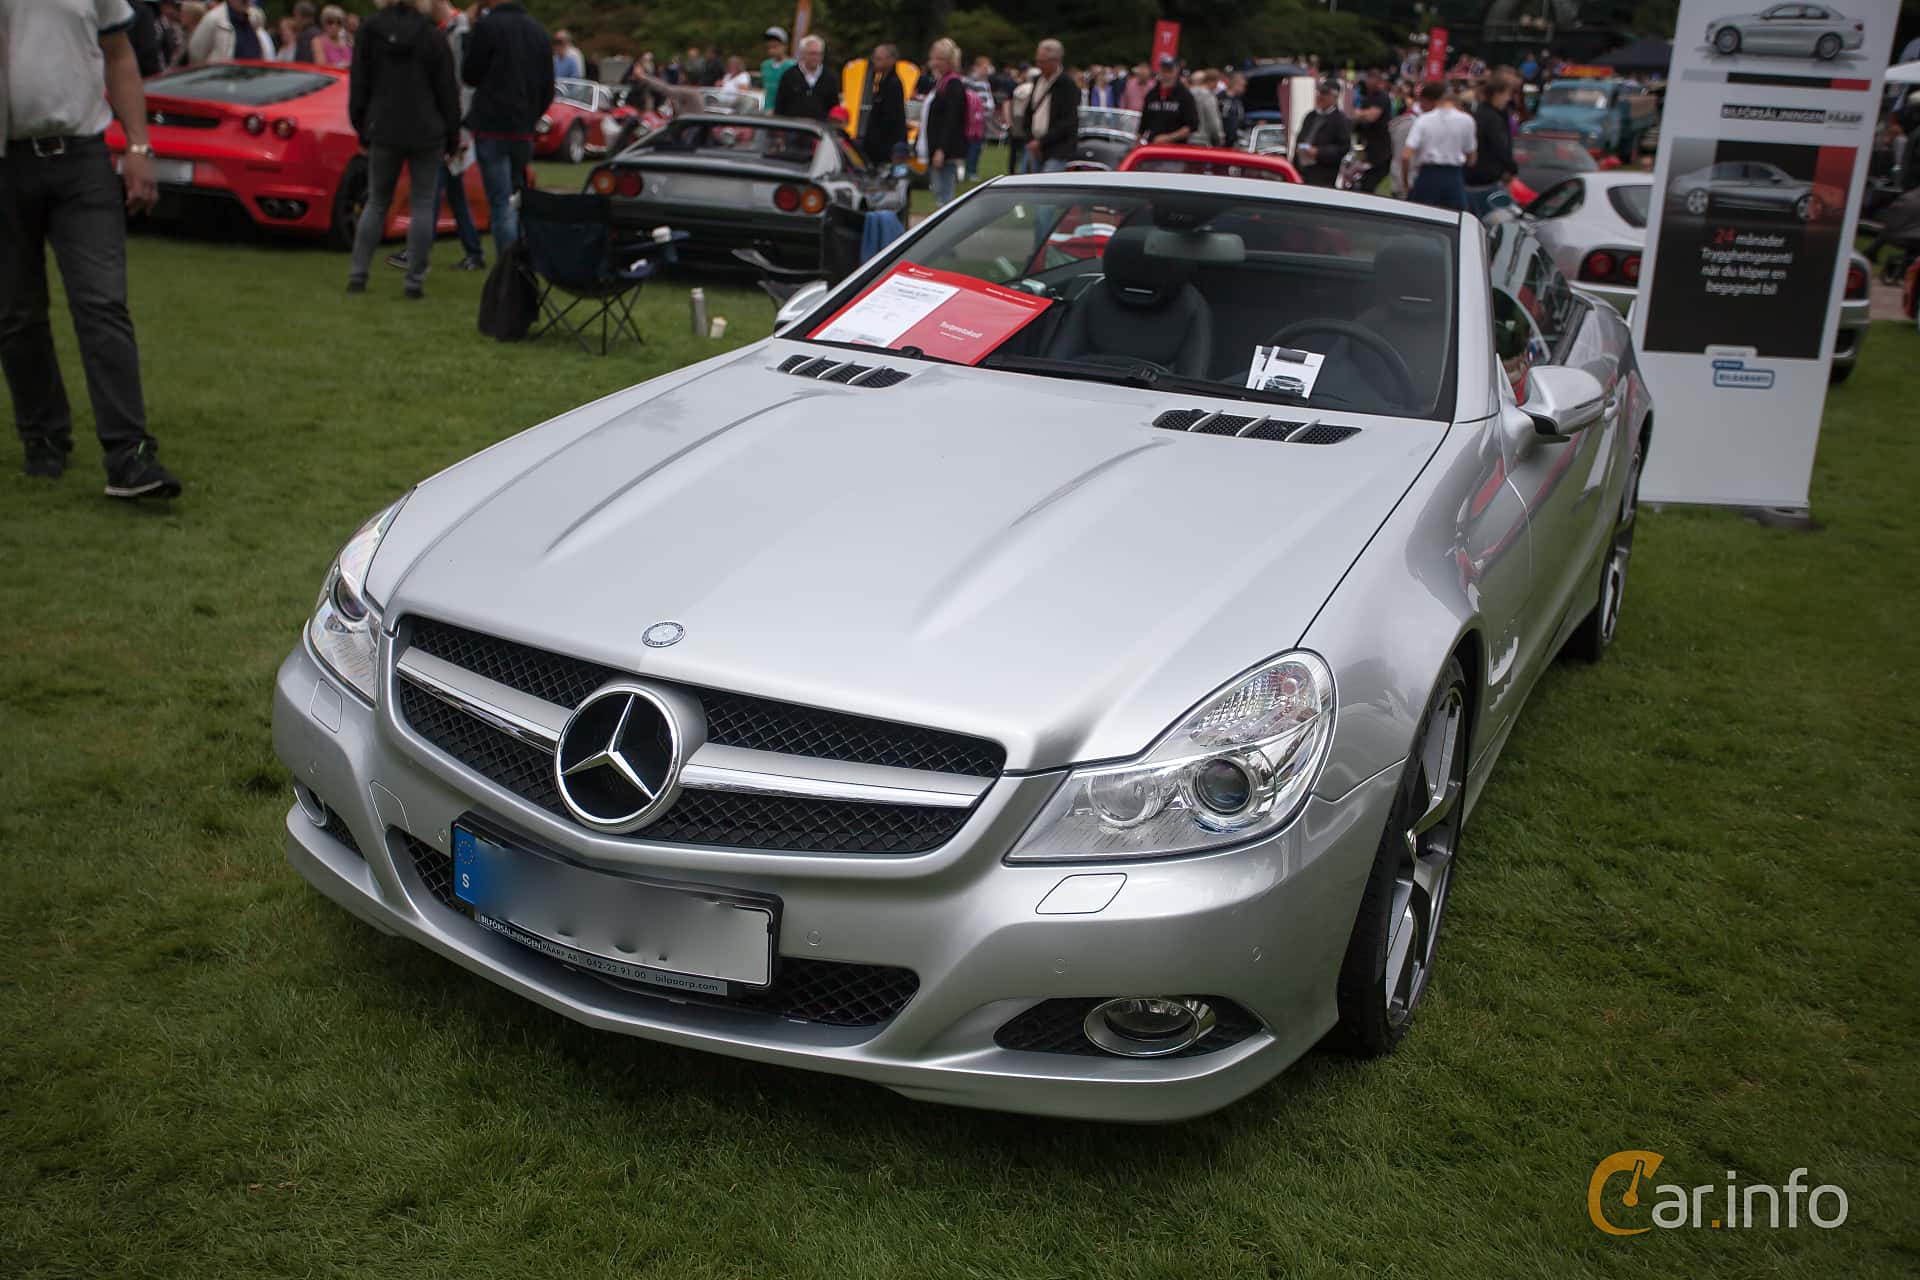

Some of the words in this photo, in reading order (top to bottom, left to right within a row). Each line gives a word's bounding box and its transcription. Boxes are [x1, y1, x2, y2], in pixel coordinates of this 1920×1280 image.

[1713, 227, 1736, 244] 24
[462, 873, 470, 888] S
[586, 958, 617, 973] 042-22
[620, 967, 631, 976] 91
[634, 970, 646, 979] 00
[655, 974, 718, 992] bilpaarp.com
